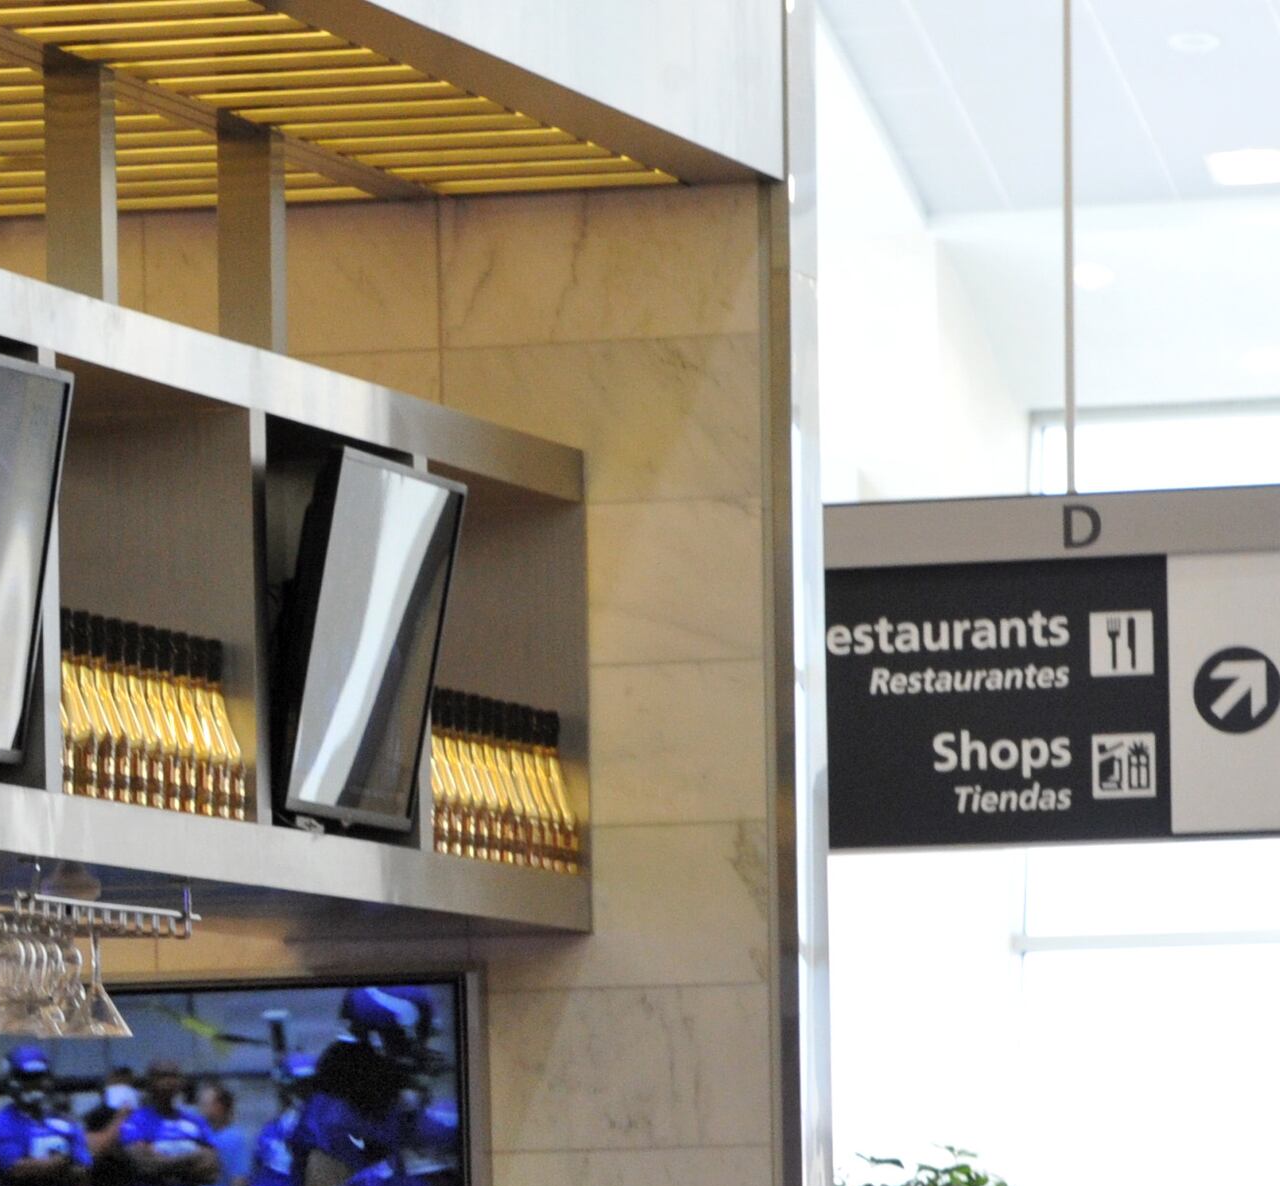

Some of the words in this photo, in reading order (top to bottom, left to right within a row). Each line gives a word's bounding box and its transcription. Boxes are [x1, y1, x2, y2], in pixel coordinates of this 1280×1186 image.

[1061, 504, 1102, 549] D
[826, 610, 1071, 656] estaurants
[869, 663, 1070, 696] Restaurantes
[931, 729, 1072, 779] Shops
[953, 782, 1073, 815] Tiendas
